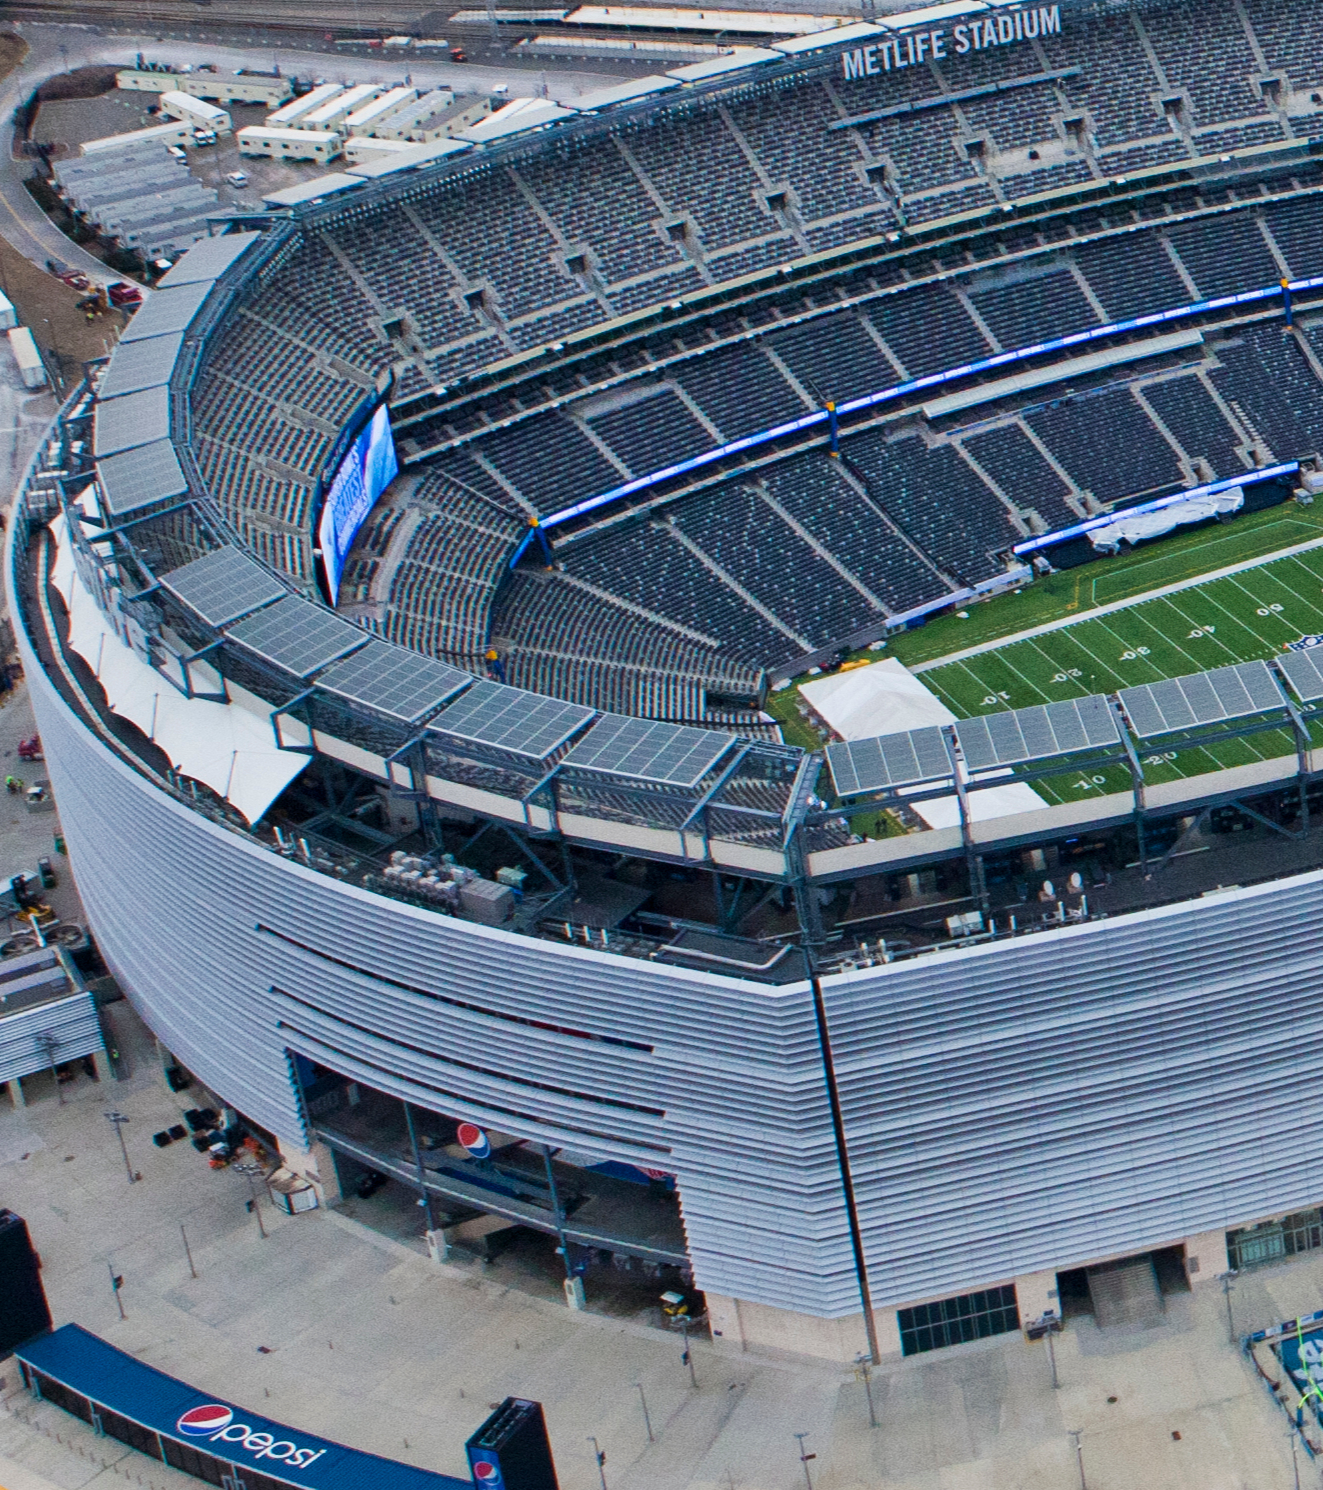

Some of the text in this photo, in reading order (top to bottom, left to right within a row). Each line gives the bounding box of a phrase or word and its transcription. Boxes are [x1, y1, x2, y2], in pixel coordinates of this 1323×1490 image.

[842, 5, 1062, 80] METLIFE STADIUM
[1256, 603, 1284, 617] 50
[1190, 625, 1216, 639] 40
[1122, 646, 1151, 661] 30
[1054, 668, 1083, 683] 20
[984, 690, 1011, 705] 10
[1148, 751, 1178, 766] 20
[1076, 775, 1106, 791] 10
[209, 1424, 327, 1469] pepsi
